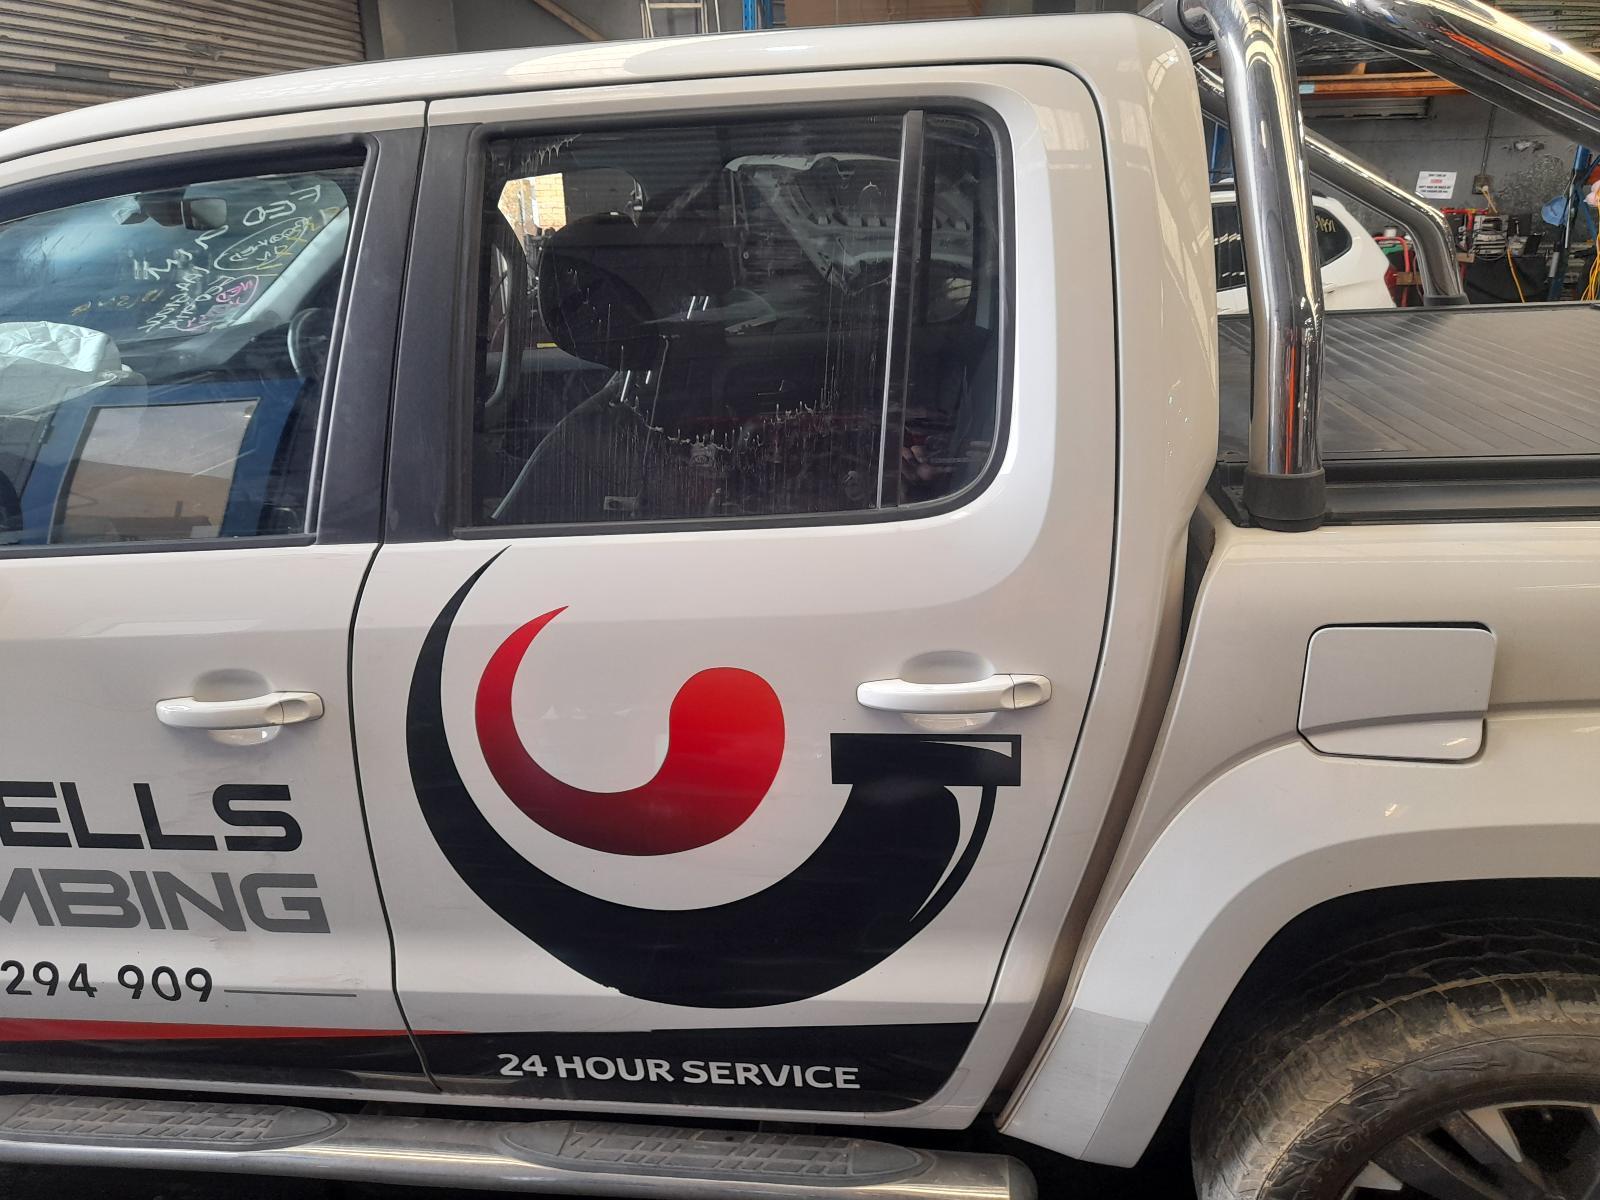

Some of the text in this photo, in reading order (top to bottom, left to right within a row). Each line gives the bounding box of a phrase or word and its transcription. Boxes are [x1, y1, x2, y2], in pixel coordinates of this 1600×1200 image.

[0, 781, 303, 852] ELLS
[1, 960, 213, 1003] 294 909
[497, 1053, 861, 1090] 24 HOUR SERVICE
